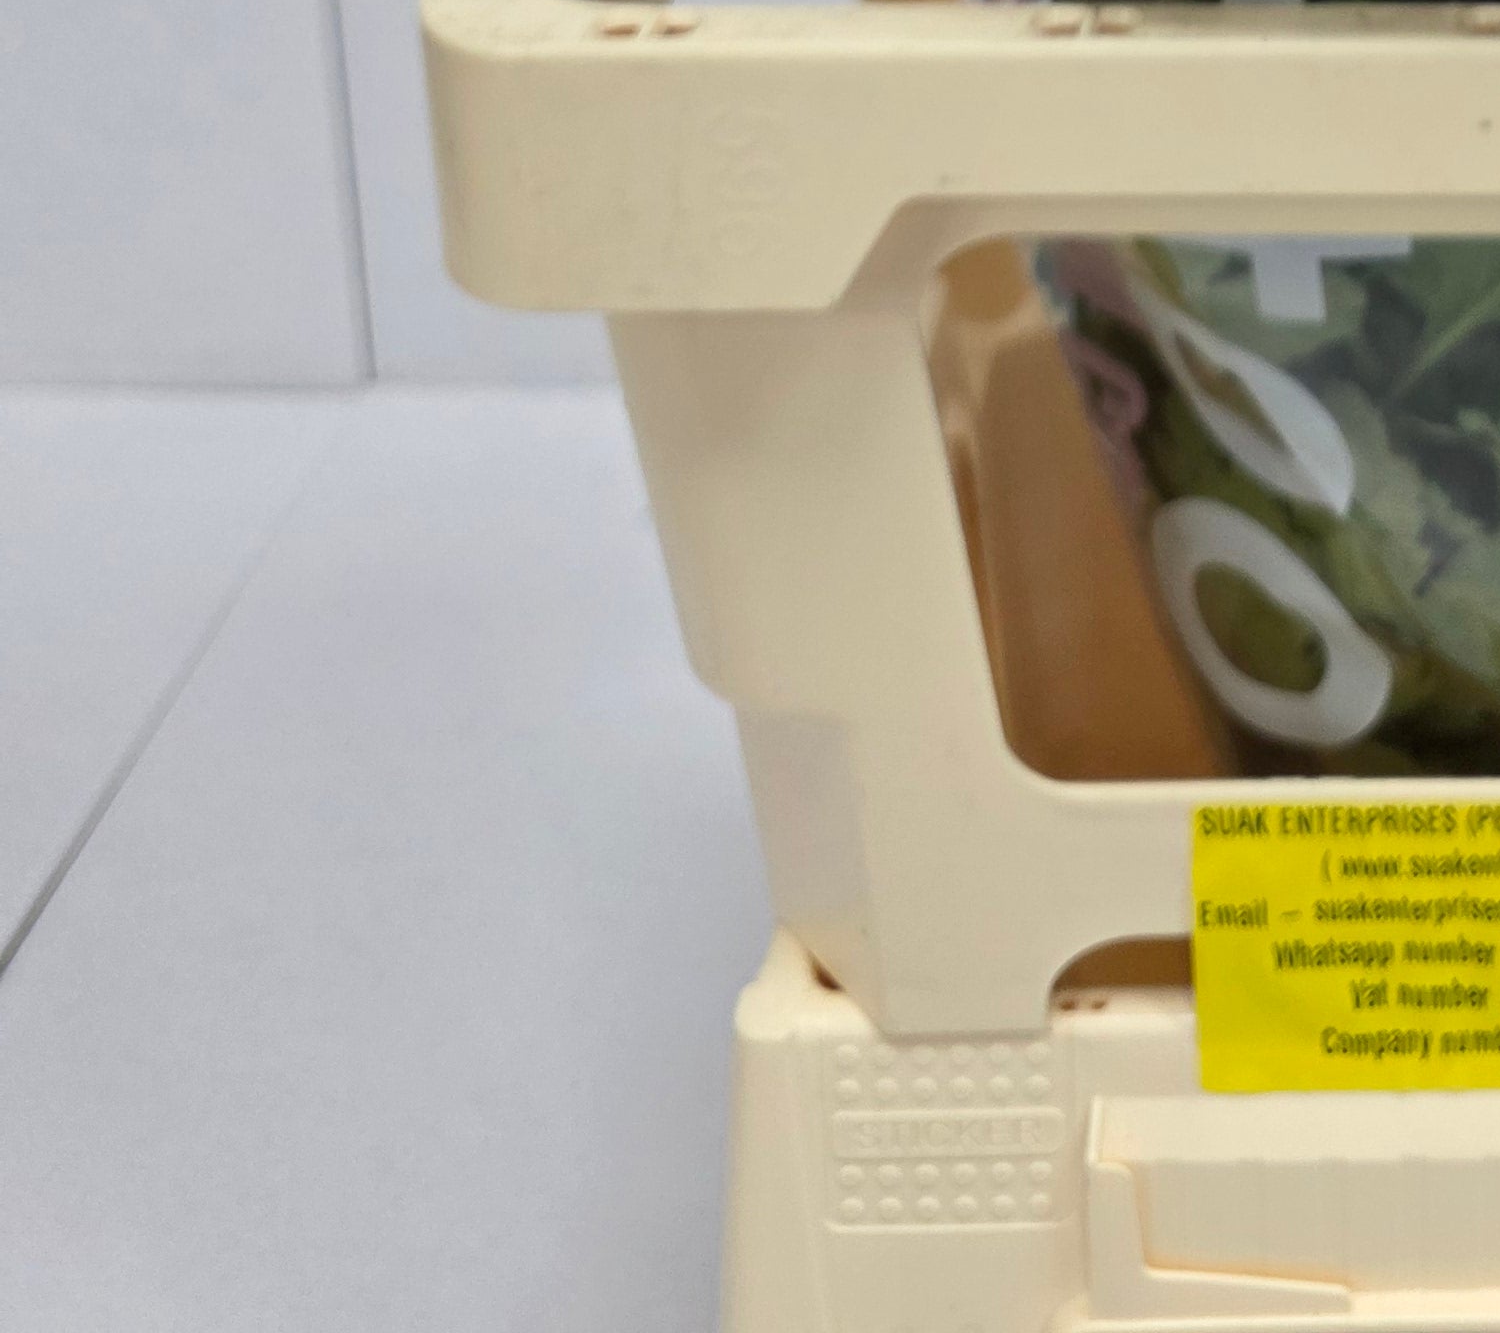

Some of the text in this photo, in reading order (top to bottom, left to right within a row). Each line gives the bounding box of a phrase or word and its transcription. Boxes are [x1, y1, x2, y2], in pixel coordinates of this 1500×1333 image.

[1200, 805, 1269, 837] SUAK
[1279, 805, 1458, 837] ENTERPRISES
[1198, 898, 1268, 928] Email
[1272, 938, 1395, 971] Whatsapp
[1402, 934, 1496, 966] number
[1350, 978, 1389, 1009] Vat
[1397, 978, 1490, 1009] number
[1320, 1025, 1433, 1060] Company
